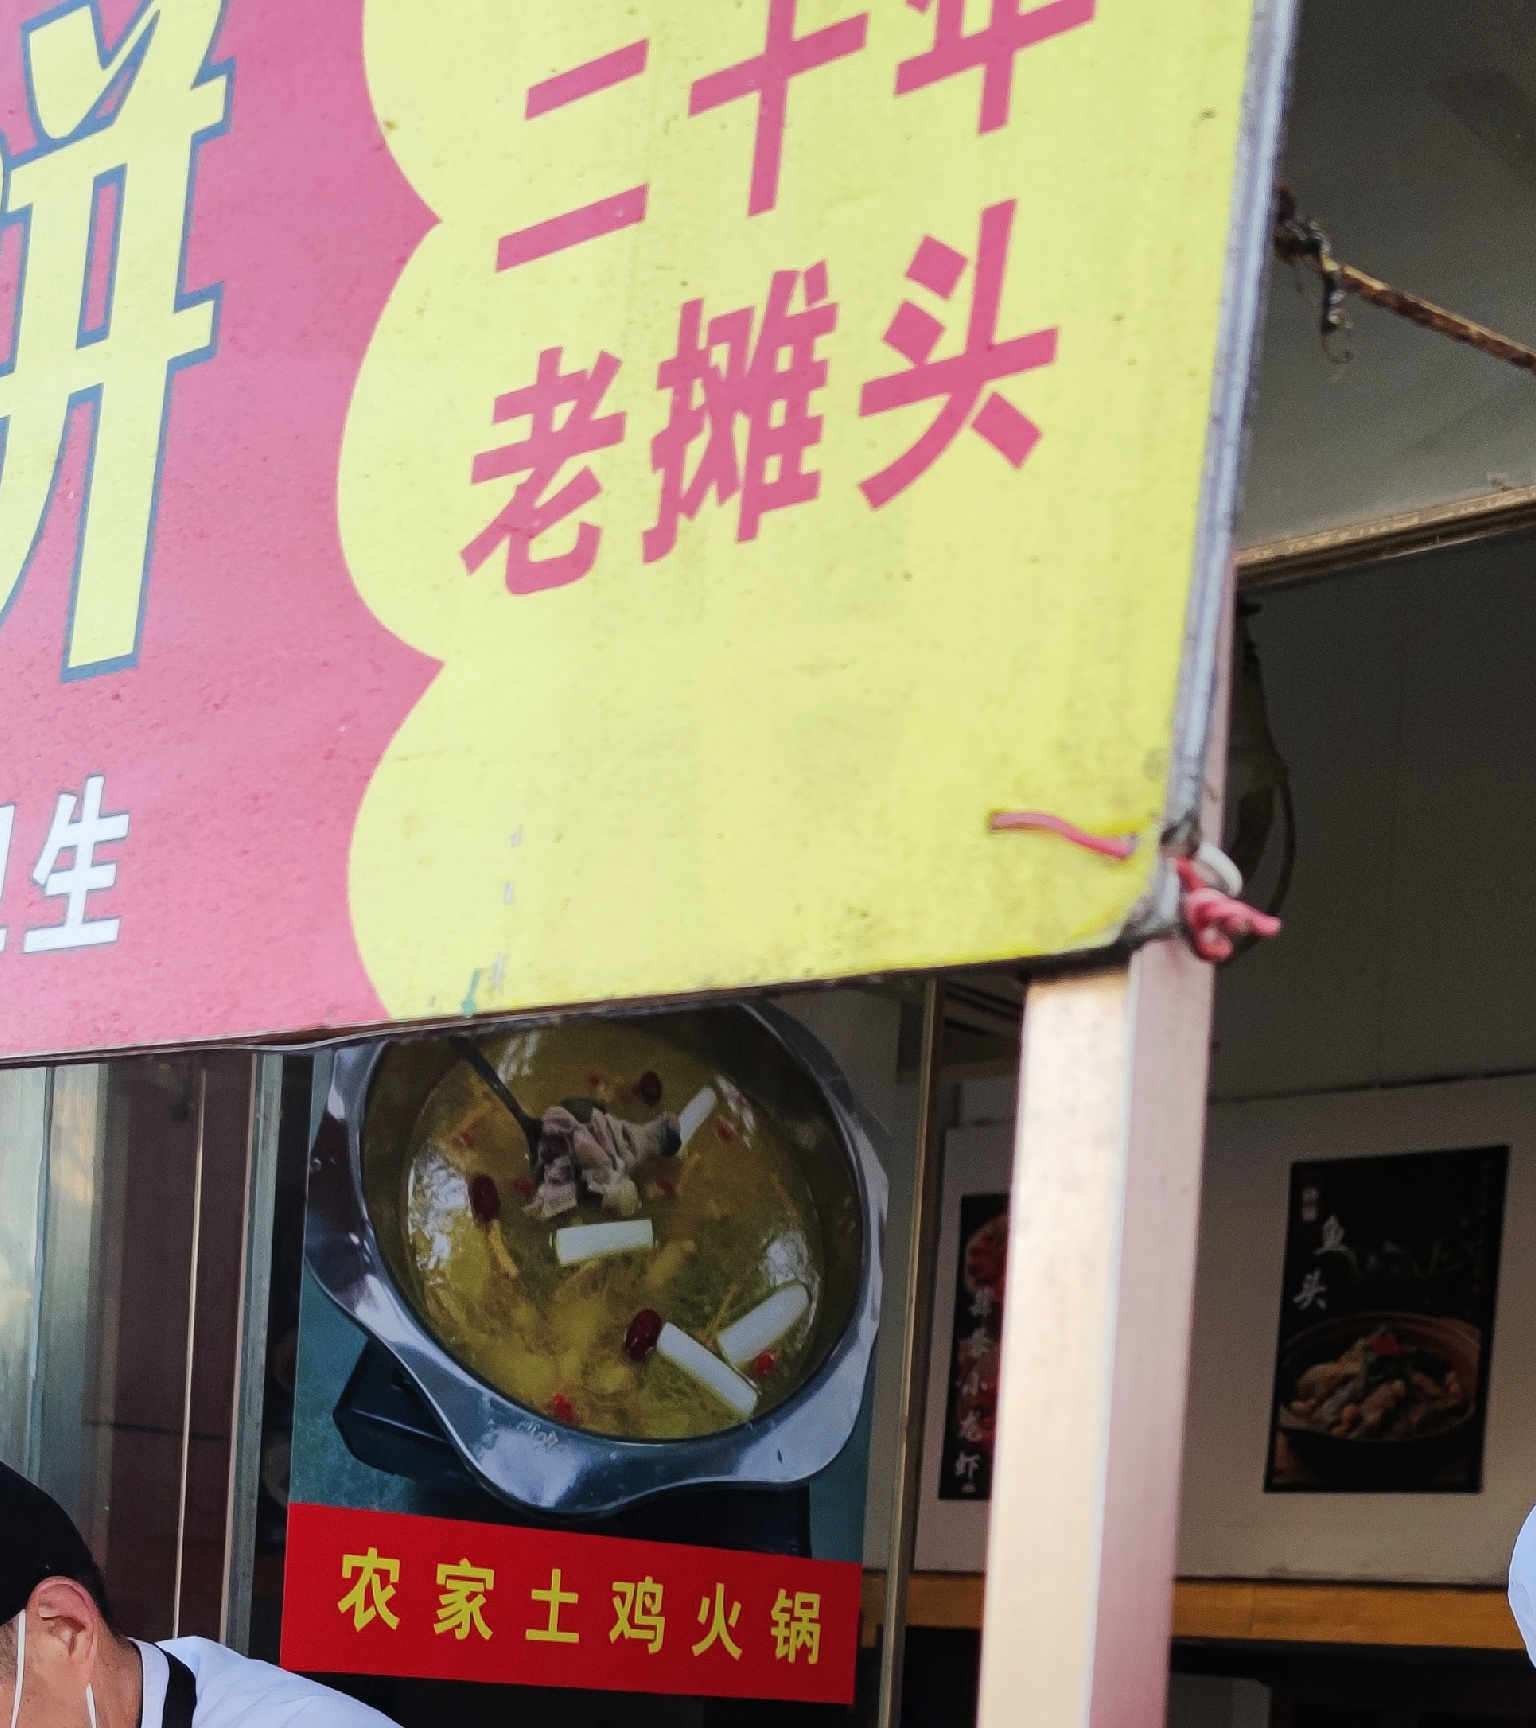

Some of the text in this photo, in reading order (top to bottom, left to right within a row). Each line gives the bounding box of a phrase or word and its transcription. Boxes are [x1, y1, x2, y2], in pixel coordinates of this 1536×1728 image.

[459, 199, 1059, 596] 老摊头
[337, 1546, 822, 1665] 农家土鸡火锅
